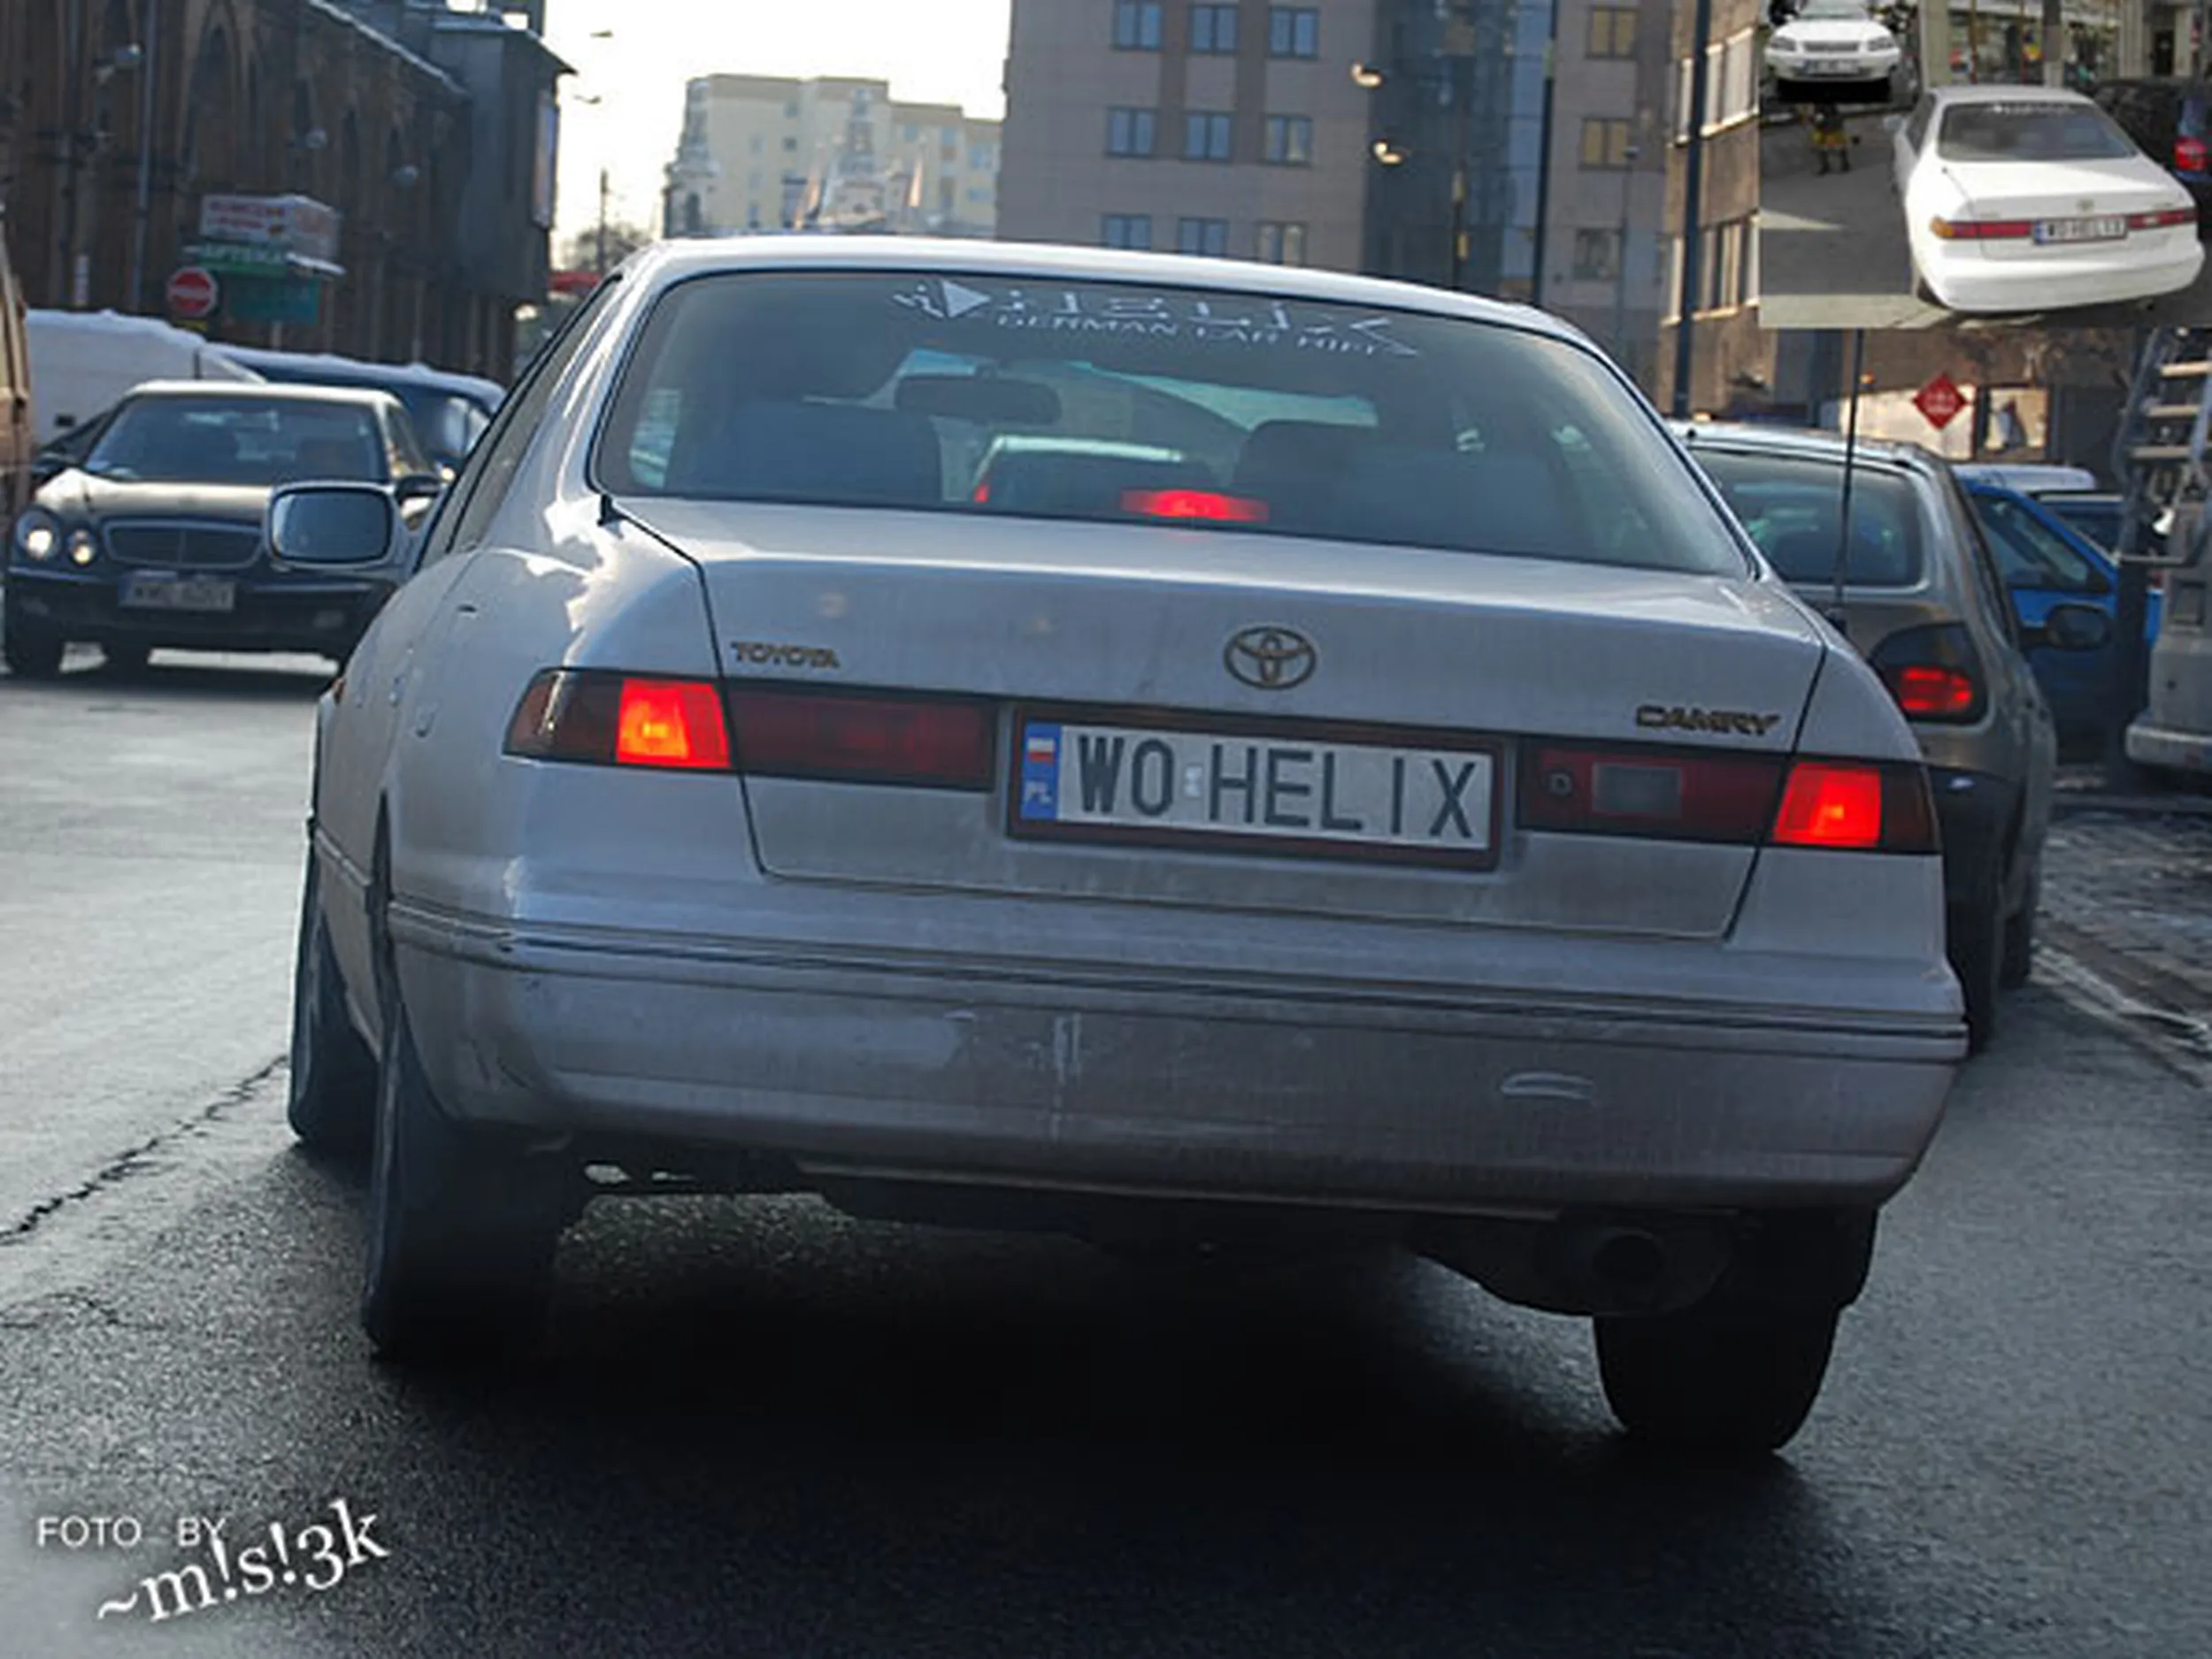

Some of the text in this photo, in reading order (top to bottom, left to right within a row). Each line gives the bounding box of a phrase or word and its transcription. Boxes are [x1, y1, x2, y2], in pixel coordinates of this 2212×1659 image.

[729, 641, 841, 669] TOYOTA
[1635, 703, 1781, 735] CAMRY
[1208, 741, 1476, 839] HELIX
